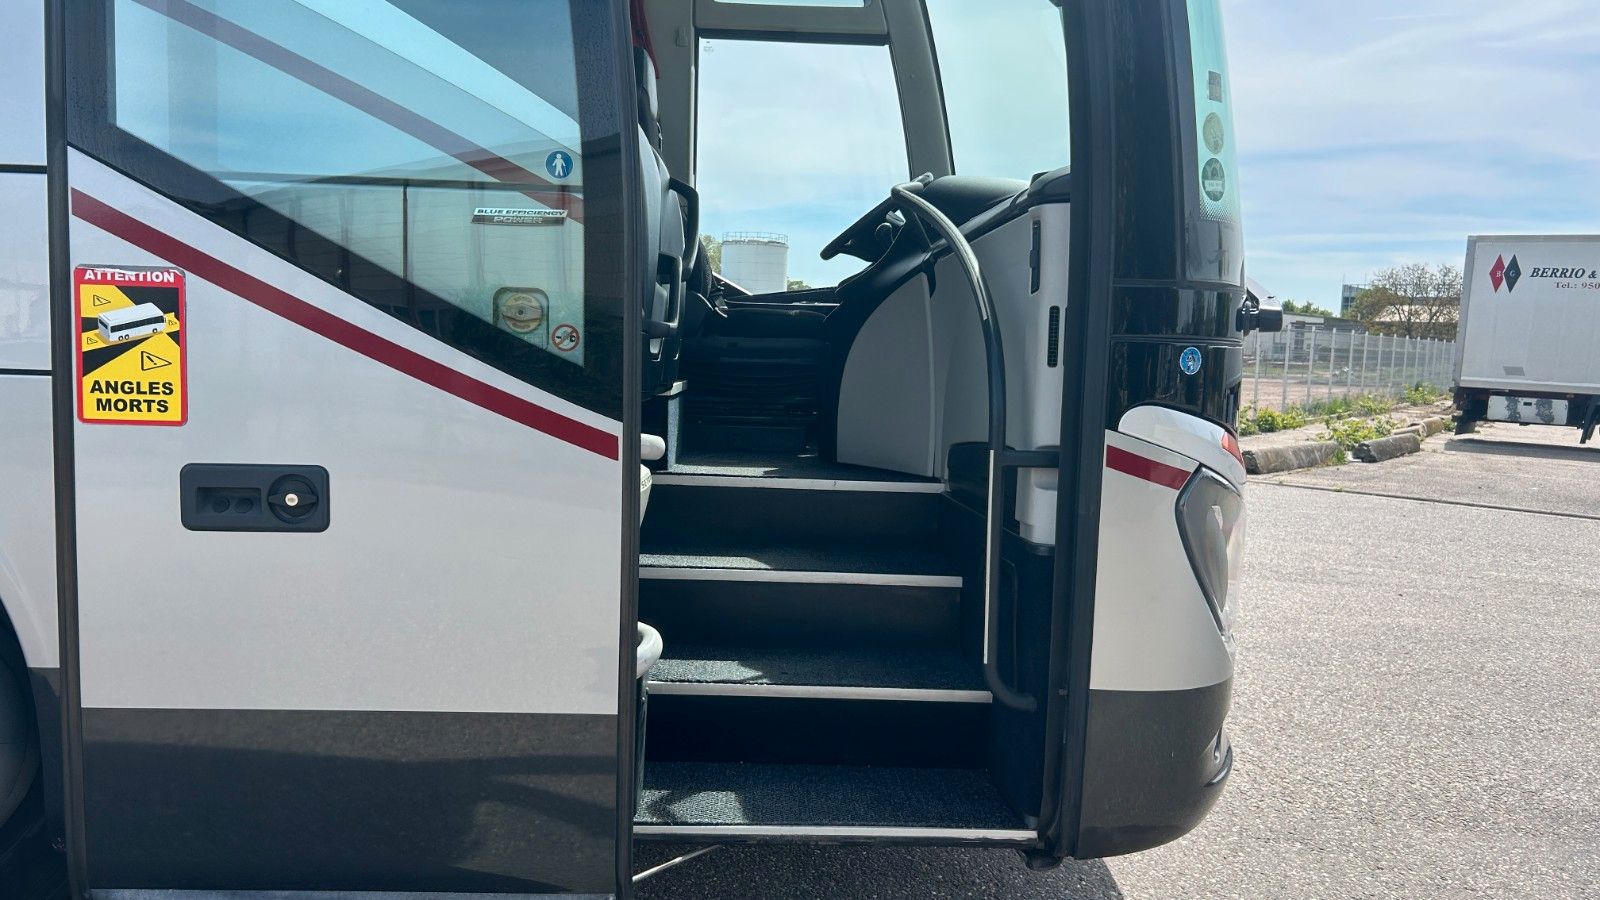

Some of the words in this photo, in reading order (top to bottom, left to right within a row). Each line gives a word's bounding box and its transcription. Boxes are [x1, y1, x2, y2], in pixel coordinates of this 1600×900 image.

[505, 209, 566, 217] EFFICIENCY
[493, 216, 543, 224] POWER
[84, 269, 175, 283] ATTENTION
[1530, 267, 1586, 279] BERRIO
[1588, 270, 1597, 279] &
[90, 380, 174, 396] ANGLES
[96, 398, 169, 413] MORTS
